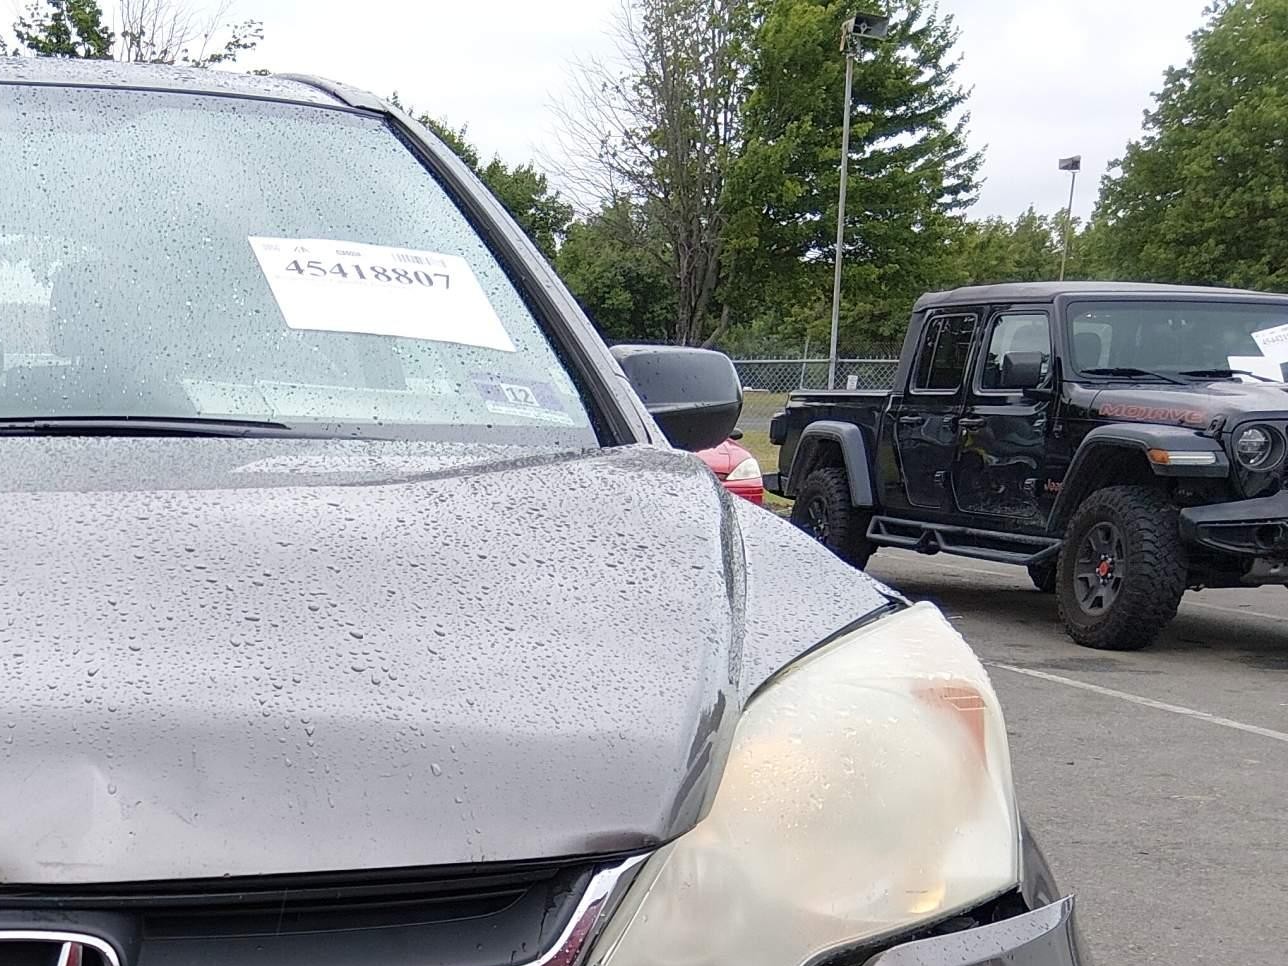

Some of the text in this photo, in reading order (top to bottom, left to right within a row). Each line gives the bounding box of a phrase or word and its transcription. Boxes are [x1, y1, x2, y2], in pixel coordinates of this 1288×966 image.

[285, 259, 450, 290] 45418807
[505, 387, 535, 405] 12
[1098, 403, 1203, 424] MOJAVE
